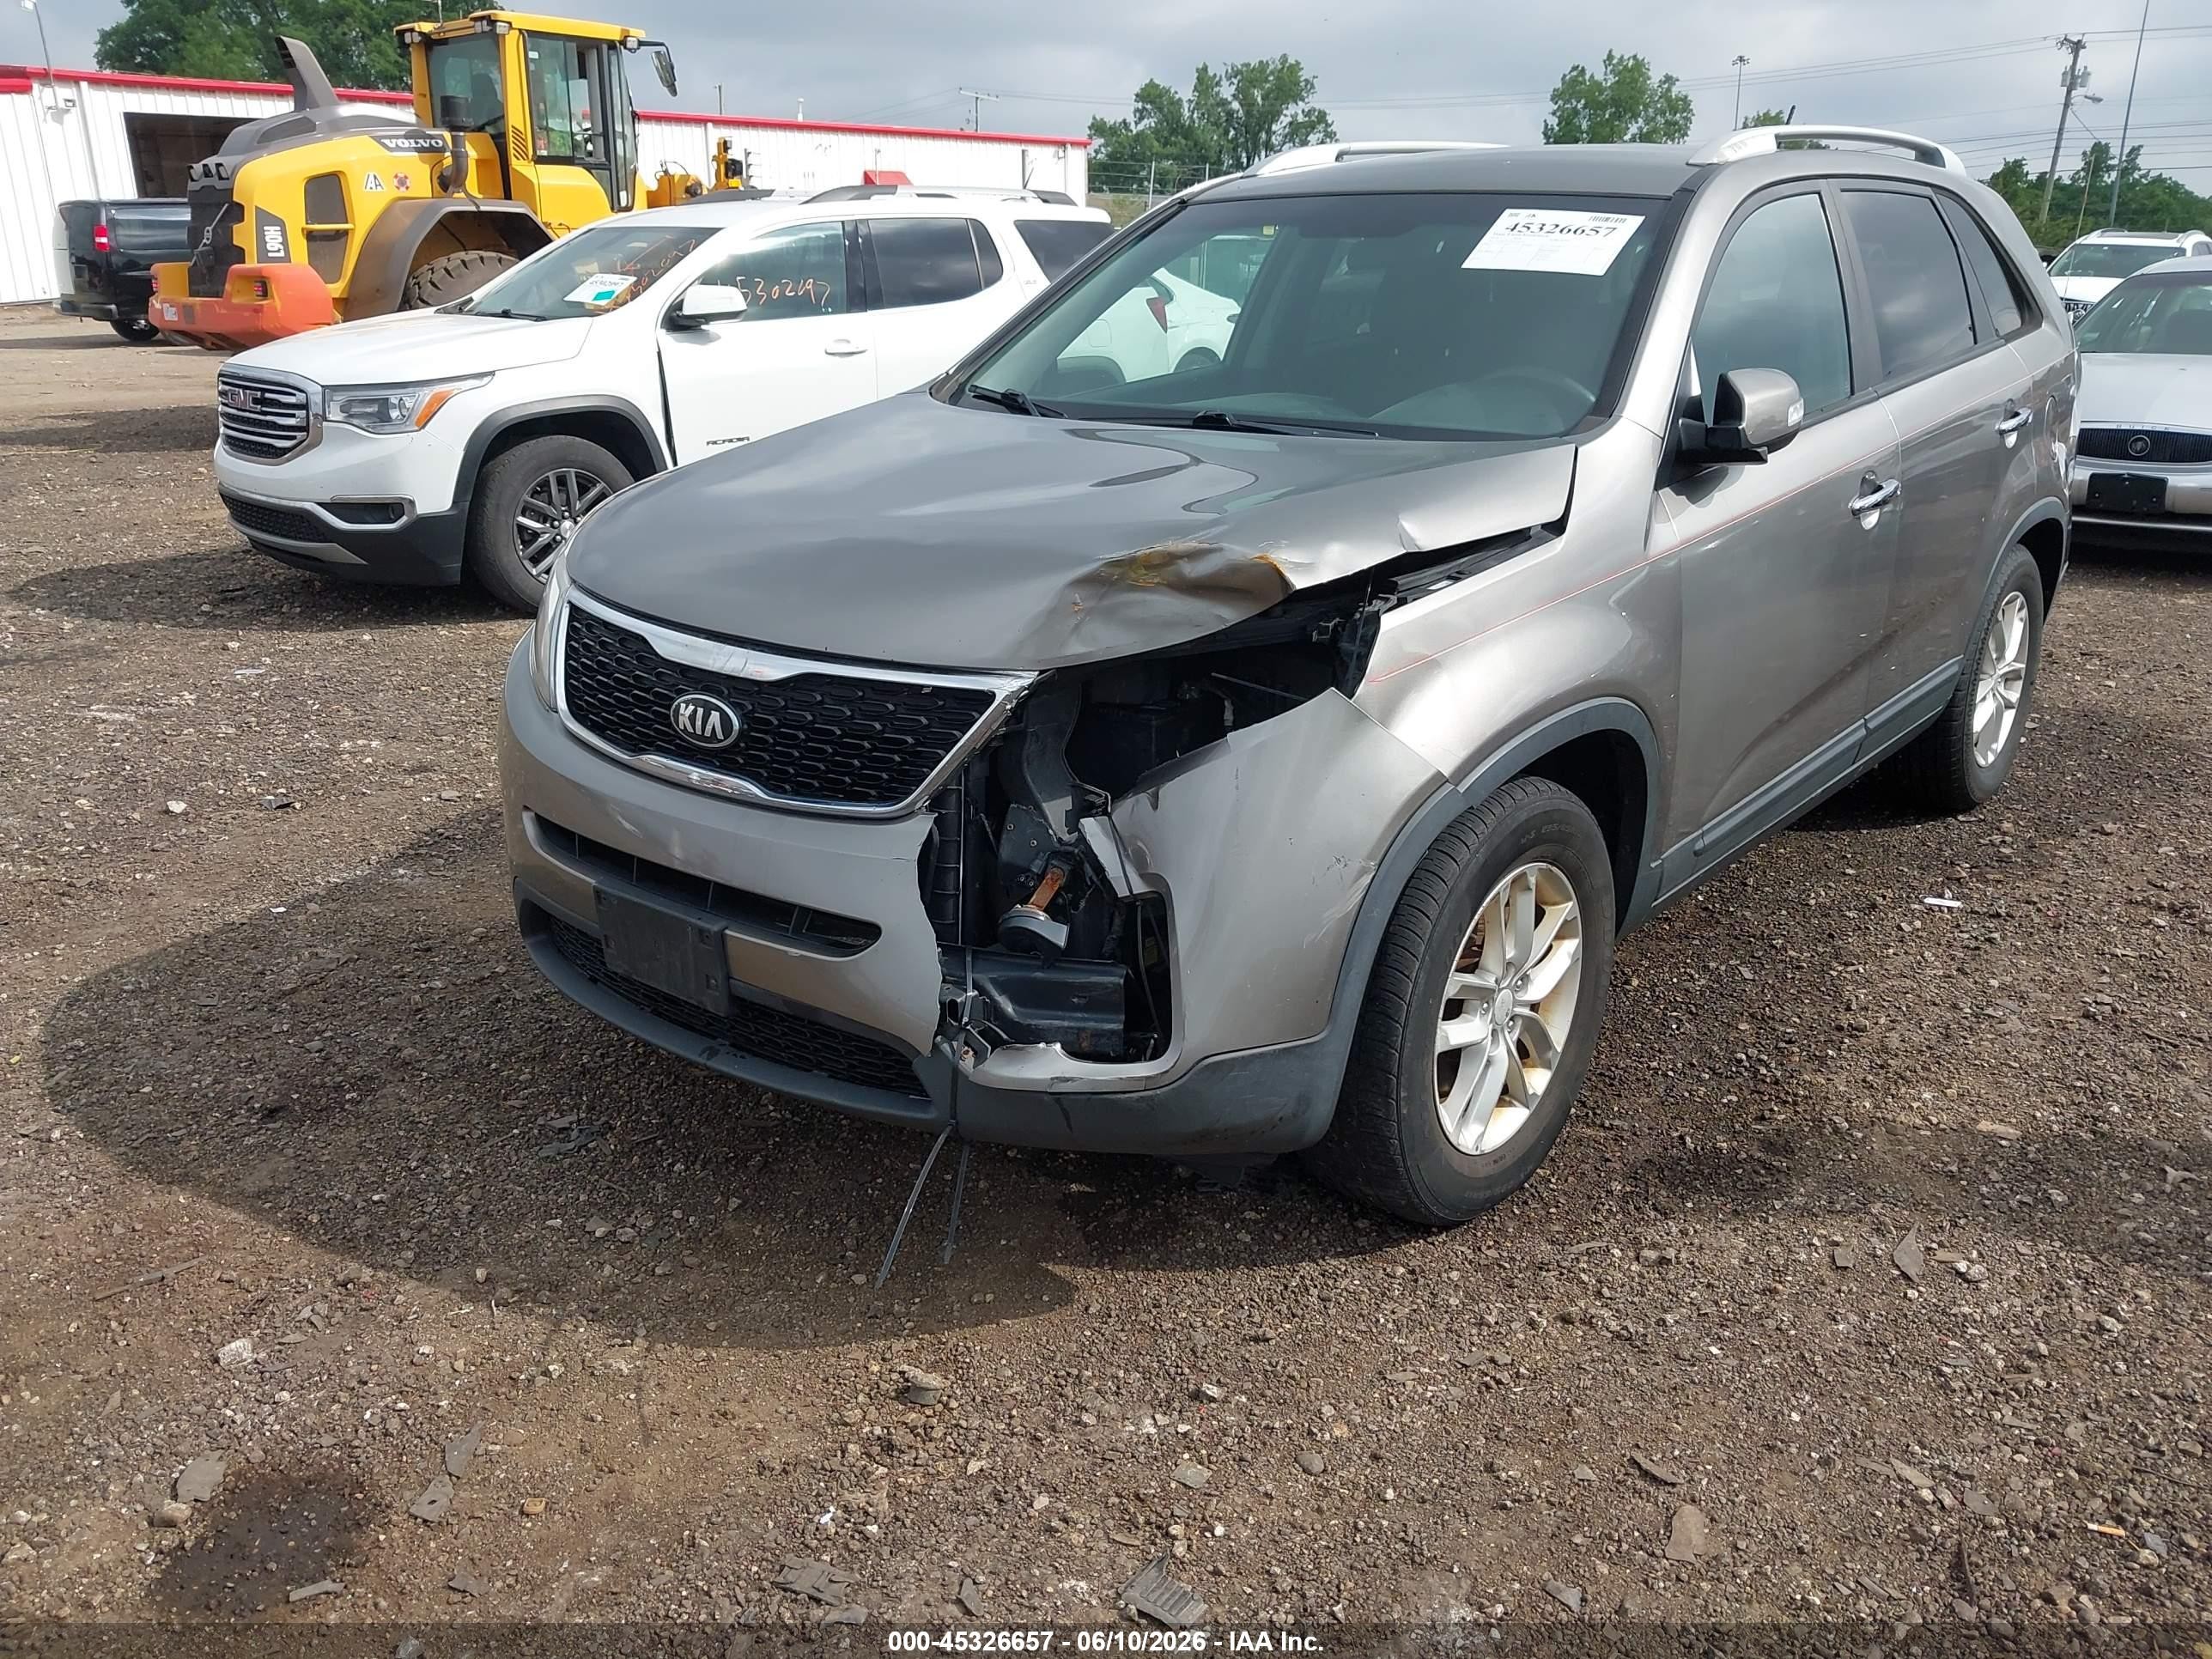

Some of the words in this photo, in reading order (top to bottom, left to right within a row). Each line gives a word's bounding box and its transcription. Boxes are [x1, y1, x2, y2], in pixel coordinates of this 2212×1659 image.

[380, 138, 443, 148] VOLVO
[1504, 221, 1618, 238] 45326657
[263, 226, 285, 258] L90H
[228, 388, 262, 412] GMC
[706, 435, 750, 447] ACADIA
[678, 702, 725, 740] KIA
